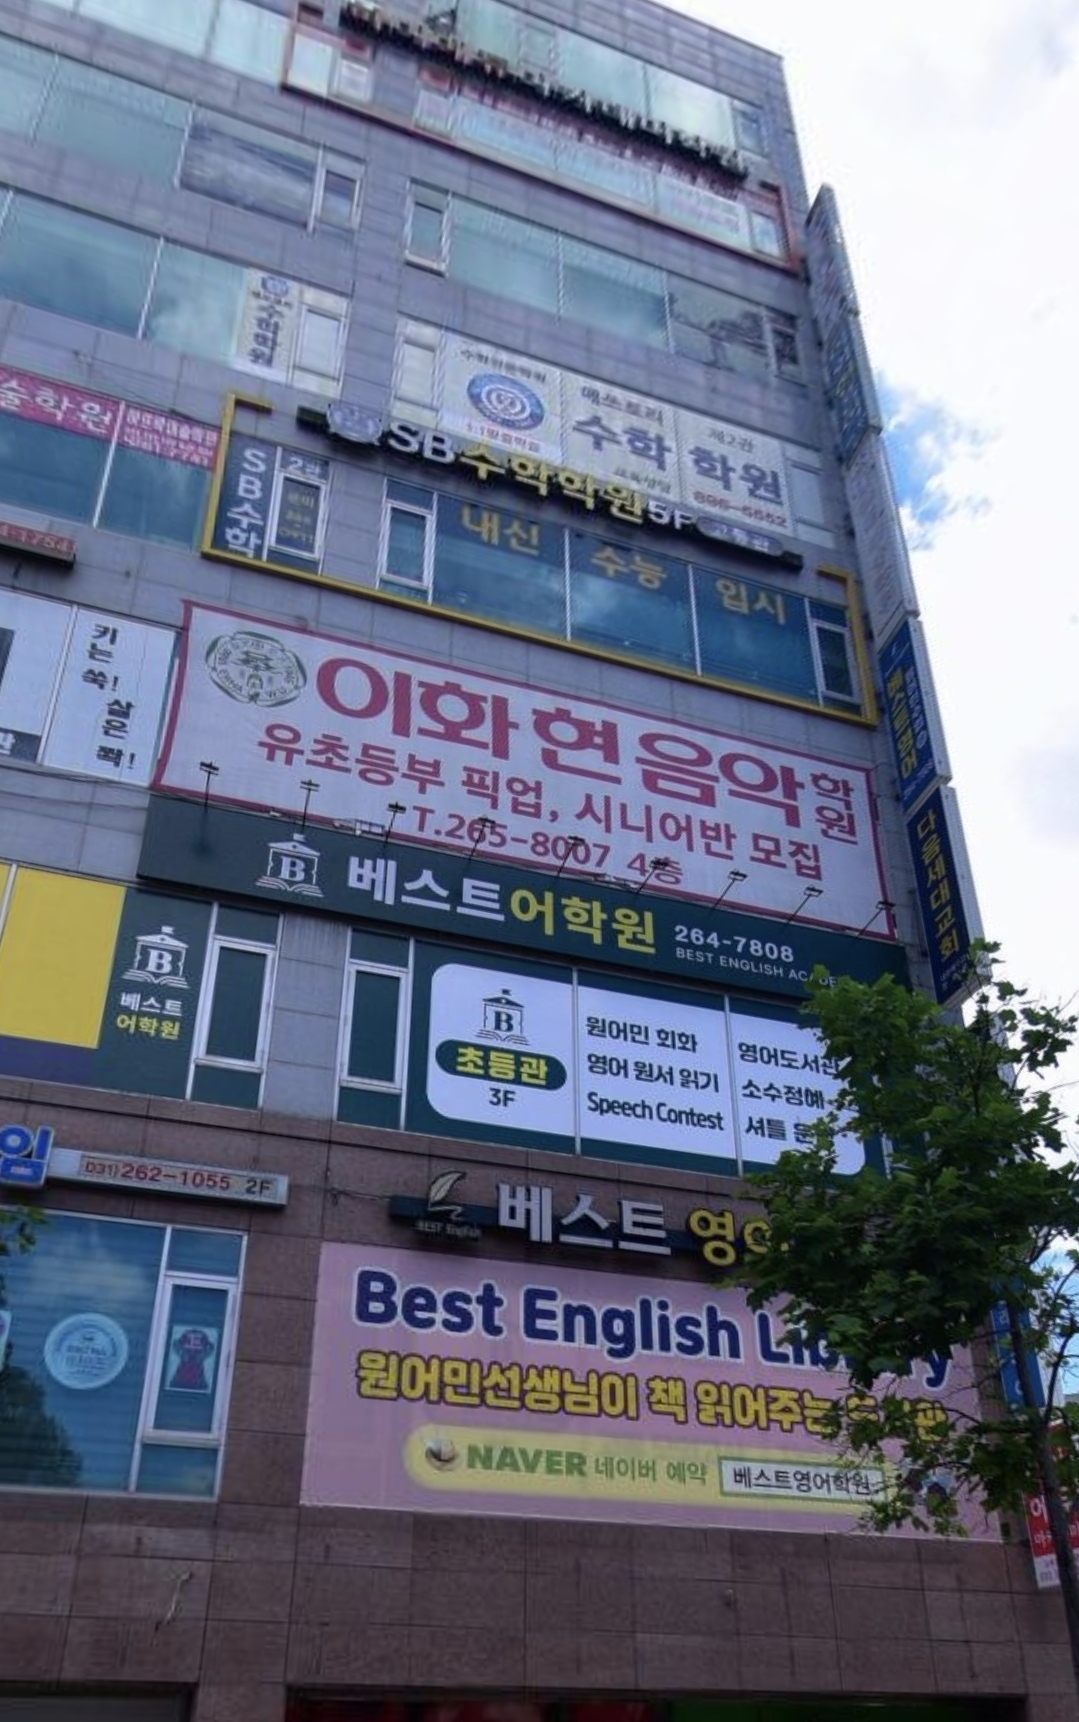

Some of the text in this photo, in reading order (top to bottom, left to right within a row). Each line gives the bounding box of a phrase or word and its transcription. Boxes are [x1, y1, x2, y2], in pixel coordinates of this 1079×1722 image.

[572, 415, 783, 507] 수학 학원
[225, 448, 267, 559] SB수학
[461, 504, 541, 557] 내신
[590, 545, 668, 590] 수능
[715, 577, 786, 626] 입시
[87, 623, 119, 664] 키는
[102, 699, 136, 741] 살은
[316, 656, 804, 829] 이화현음악
[809, 772, 859, 845] 학원
[258, 722, 823, 881] 유초등부 픽업, 시니어반 모집
[412, 805, 684, 886] T.265-8007 4층
[916, 808, 960, 964] 다음세대교회
[673, 925, 795, 963] 264-7808
[675, 946, 714, 967] BEST
[719, 953, 785, 978] ENGLISH
[120, 992, 183, 1017] 베스트
[116, 1015, 181, 1040] 어학원
[586, 1016, 698, 1053] 원어민 회화
[455, 1046, 548, 1086] 초등관
[586, 1053, 720, 1093] 영어 원서 읽기
[488, 1087, 516, 1107] 3F
[586, 1091, 724, 1131] Speech Contest
[742, 1079, 825, 1110] 소수정예
[744, 1116, 816, 1145] 셔틀 운
[245, 1178, 275, 1195] 2F
[355, 1268, 505, 1338] Best
[520, 1285, 744, 1362] English
[357, 1349, 639, 1421] 원어민선생님이
[646, 1373, 689, 1425] 책
[694, 1379, 838, 1436] 읽어주는
[467, 1443, 873, 1497] NAVER 네이버 예약 베스트영어학원
